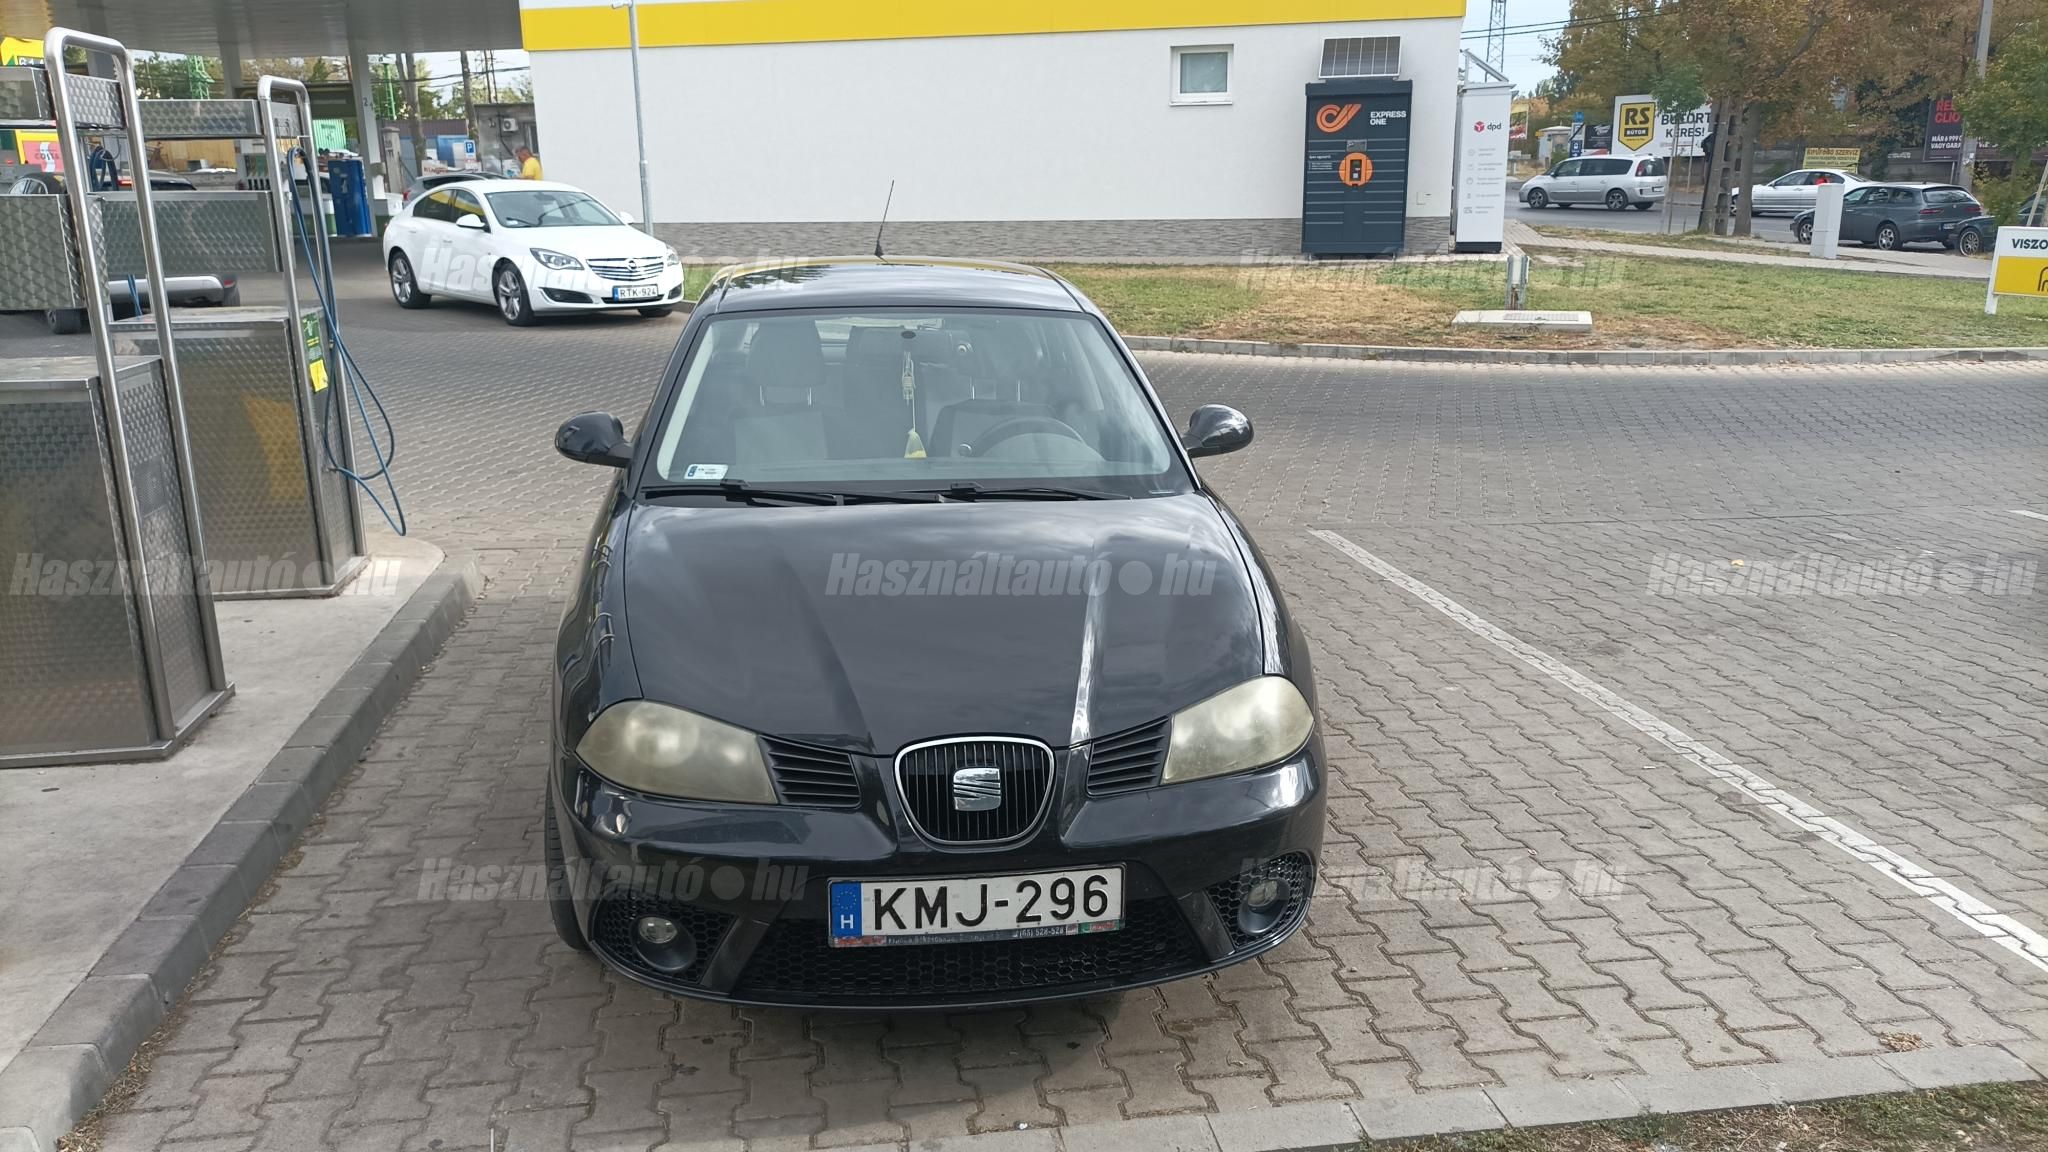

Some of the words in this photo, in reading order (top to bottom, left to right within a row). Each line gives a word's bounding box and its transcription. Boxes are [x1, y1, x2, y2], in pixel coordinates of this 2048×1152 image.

[1370, 110, 1407, 118] EXPRESS
[1625, 107, 1650, 125] RS
[1370, 118, 1387, 126] ONE
[1486, 122, 1502, 132] dpd
[466, 143, 473, 153] P
[620, 287, 657, 298] RTK-924
[873, 874, 1109, 931] KMJ-296
[840, 913, 854, 929] H
